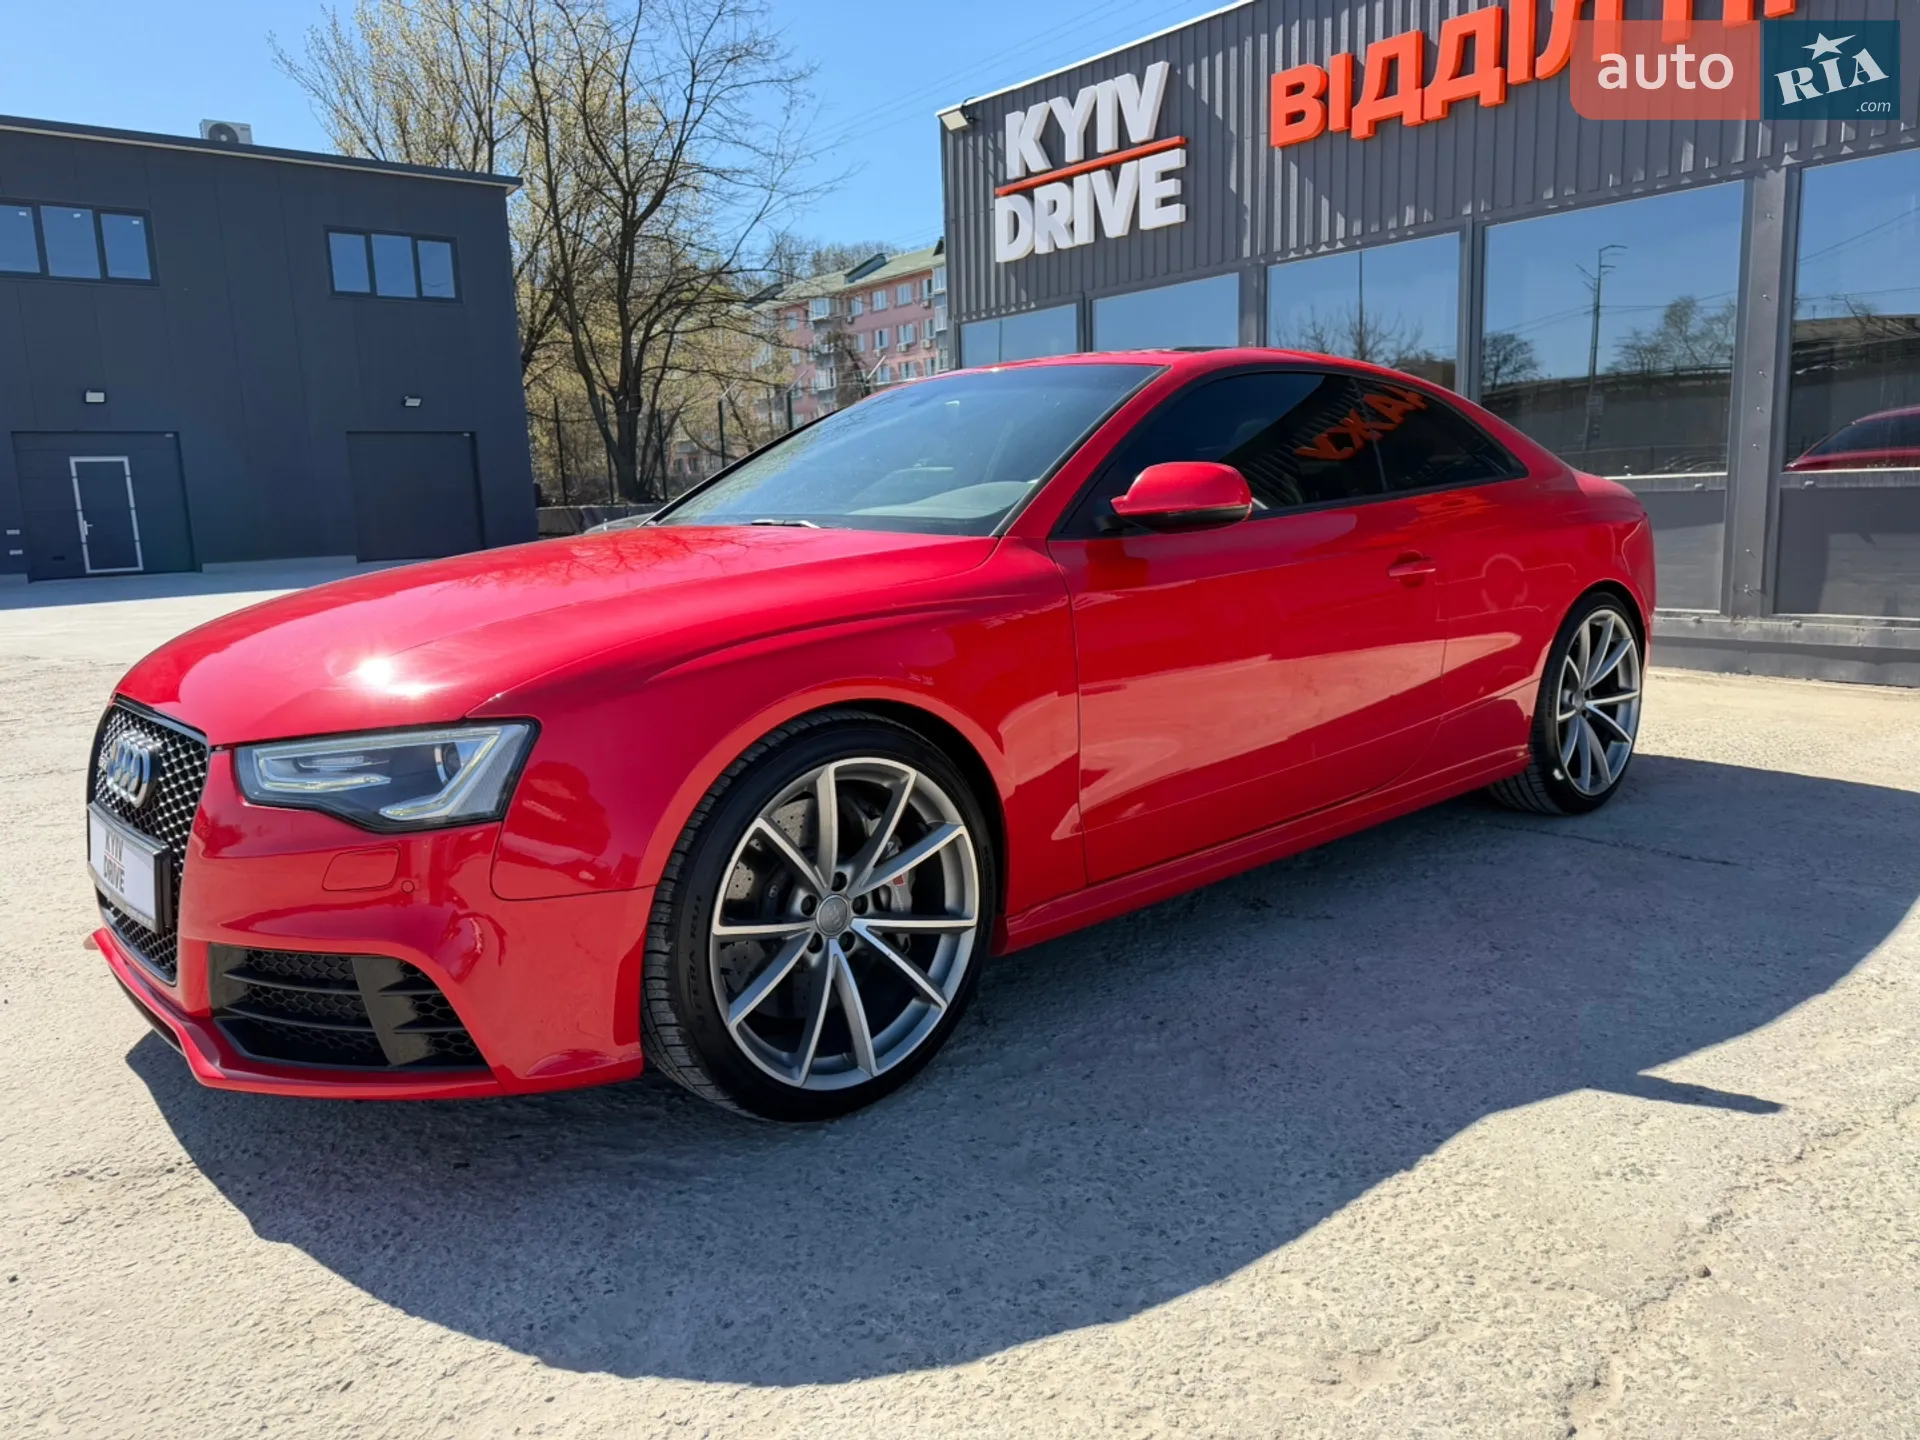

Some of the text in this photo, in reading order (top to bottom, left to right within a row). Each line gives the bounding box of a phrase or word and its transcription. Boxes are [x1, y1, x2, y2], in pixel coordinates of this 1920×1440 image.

[1005, 60, 1170, 180] KYIV
[995, 148, 1187, 263] DRIVE
[104, 854, 125, 894] DRIVE
